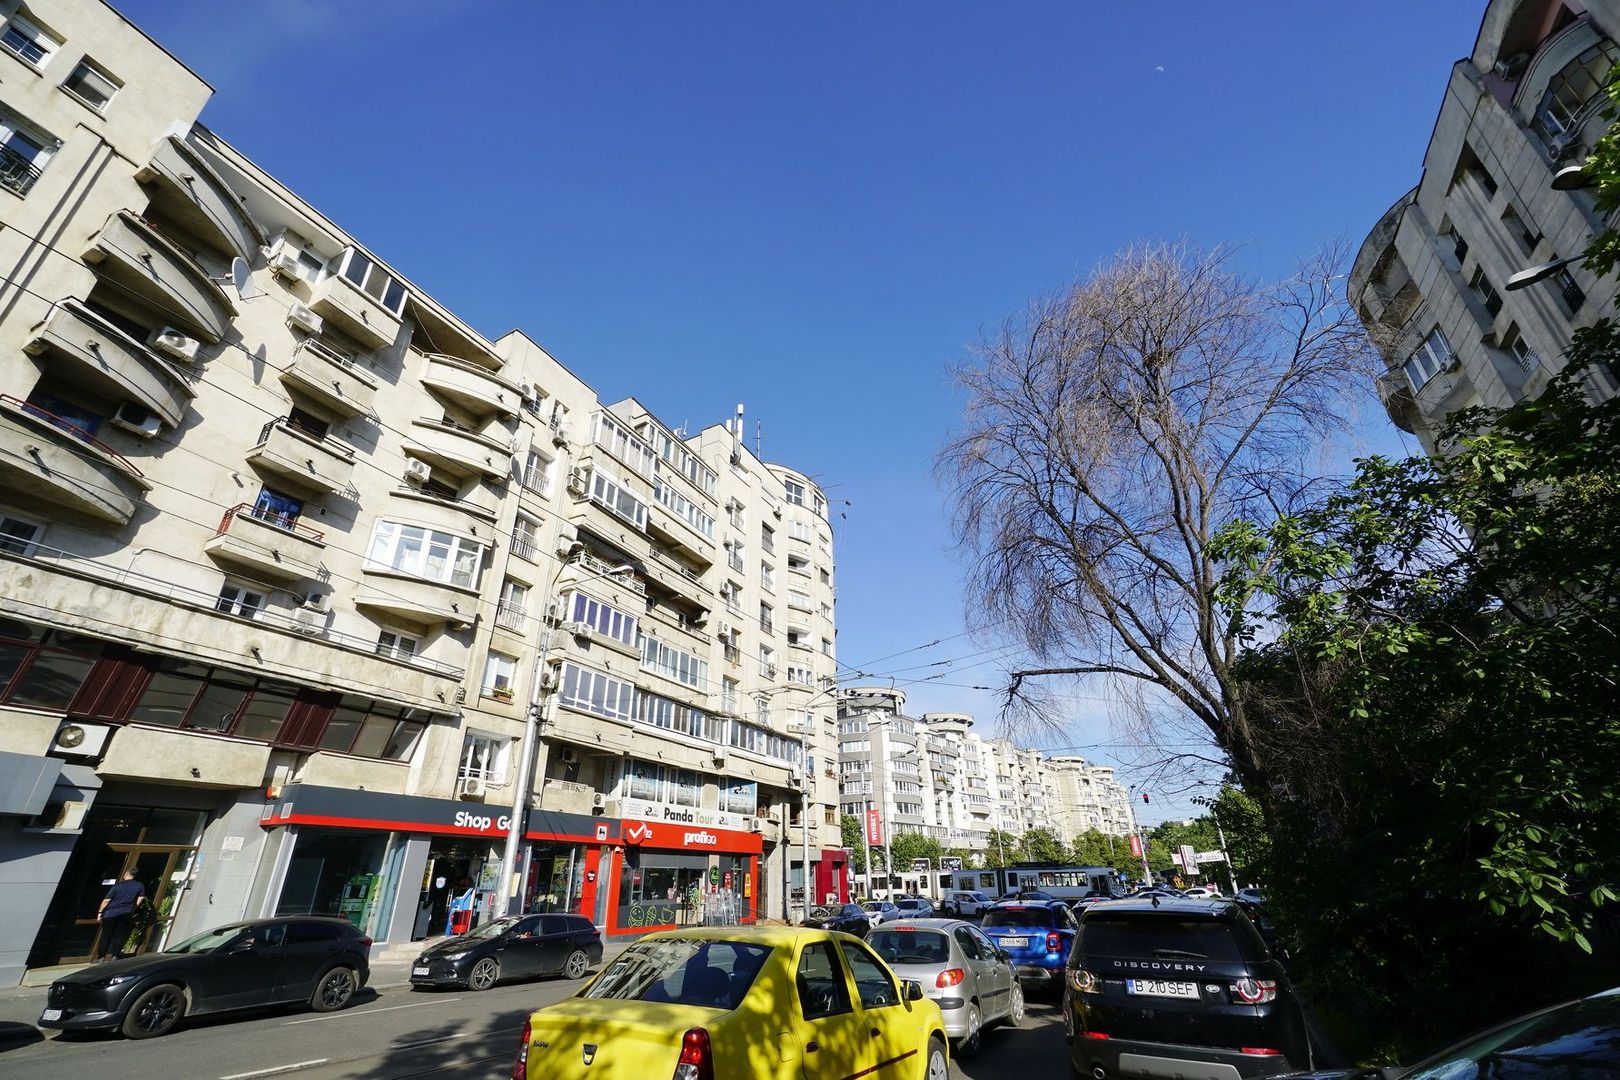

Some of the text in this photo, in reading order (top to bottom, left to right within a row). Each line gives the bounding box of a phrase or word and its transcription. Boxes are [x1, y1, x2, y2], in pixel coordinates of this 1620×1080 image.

[454, 811, 491, 832] Shop
[664, 807, 693, 823] Panda
[695, 811, 714, 825] Tour
[1113, 960, 1206, 972] DISCOVERY
[1135, 980, 1144, 992] B
[1148, 980, 1166, 994] 210
[1168, 982, 1193, 996] SEF
